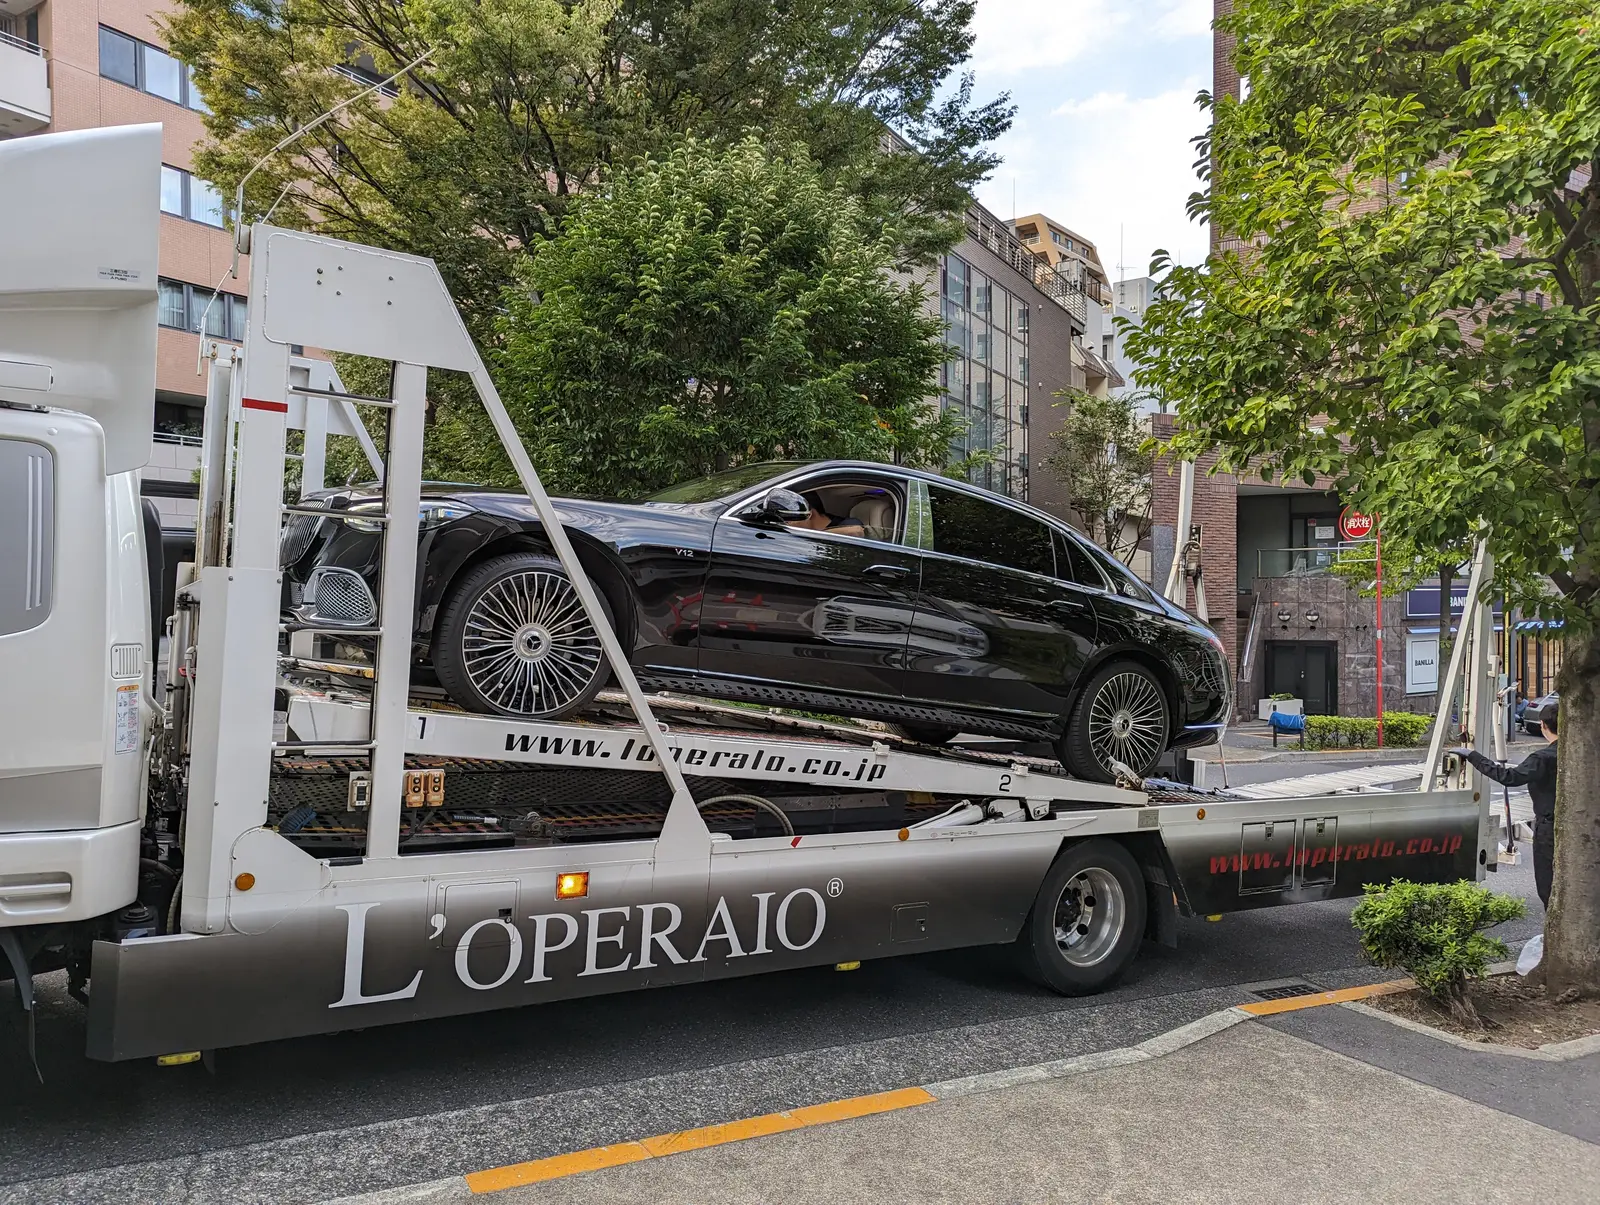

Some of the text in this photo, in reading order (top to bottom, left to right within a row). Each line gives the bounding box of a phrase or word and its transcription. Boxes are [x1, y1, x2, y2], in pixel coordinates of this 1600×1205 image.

[1347, 516, 1370, 529] 消火栓
[675, 548, 694, 558] V12
[1414, 659, 1434, 667] BANILLA
[999, 774, 1011, 792] 2
